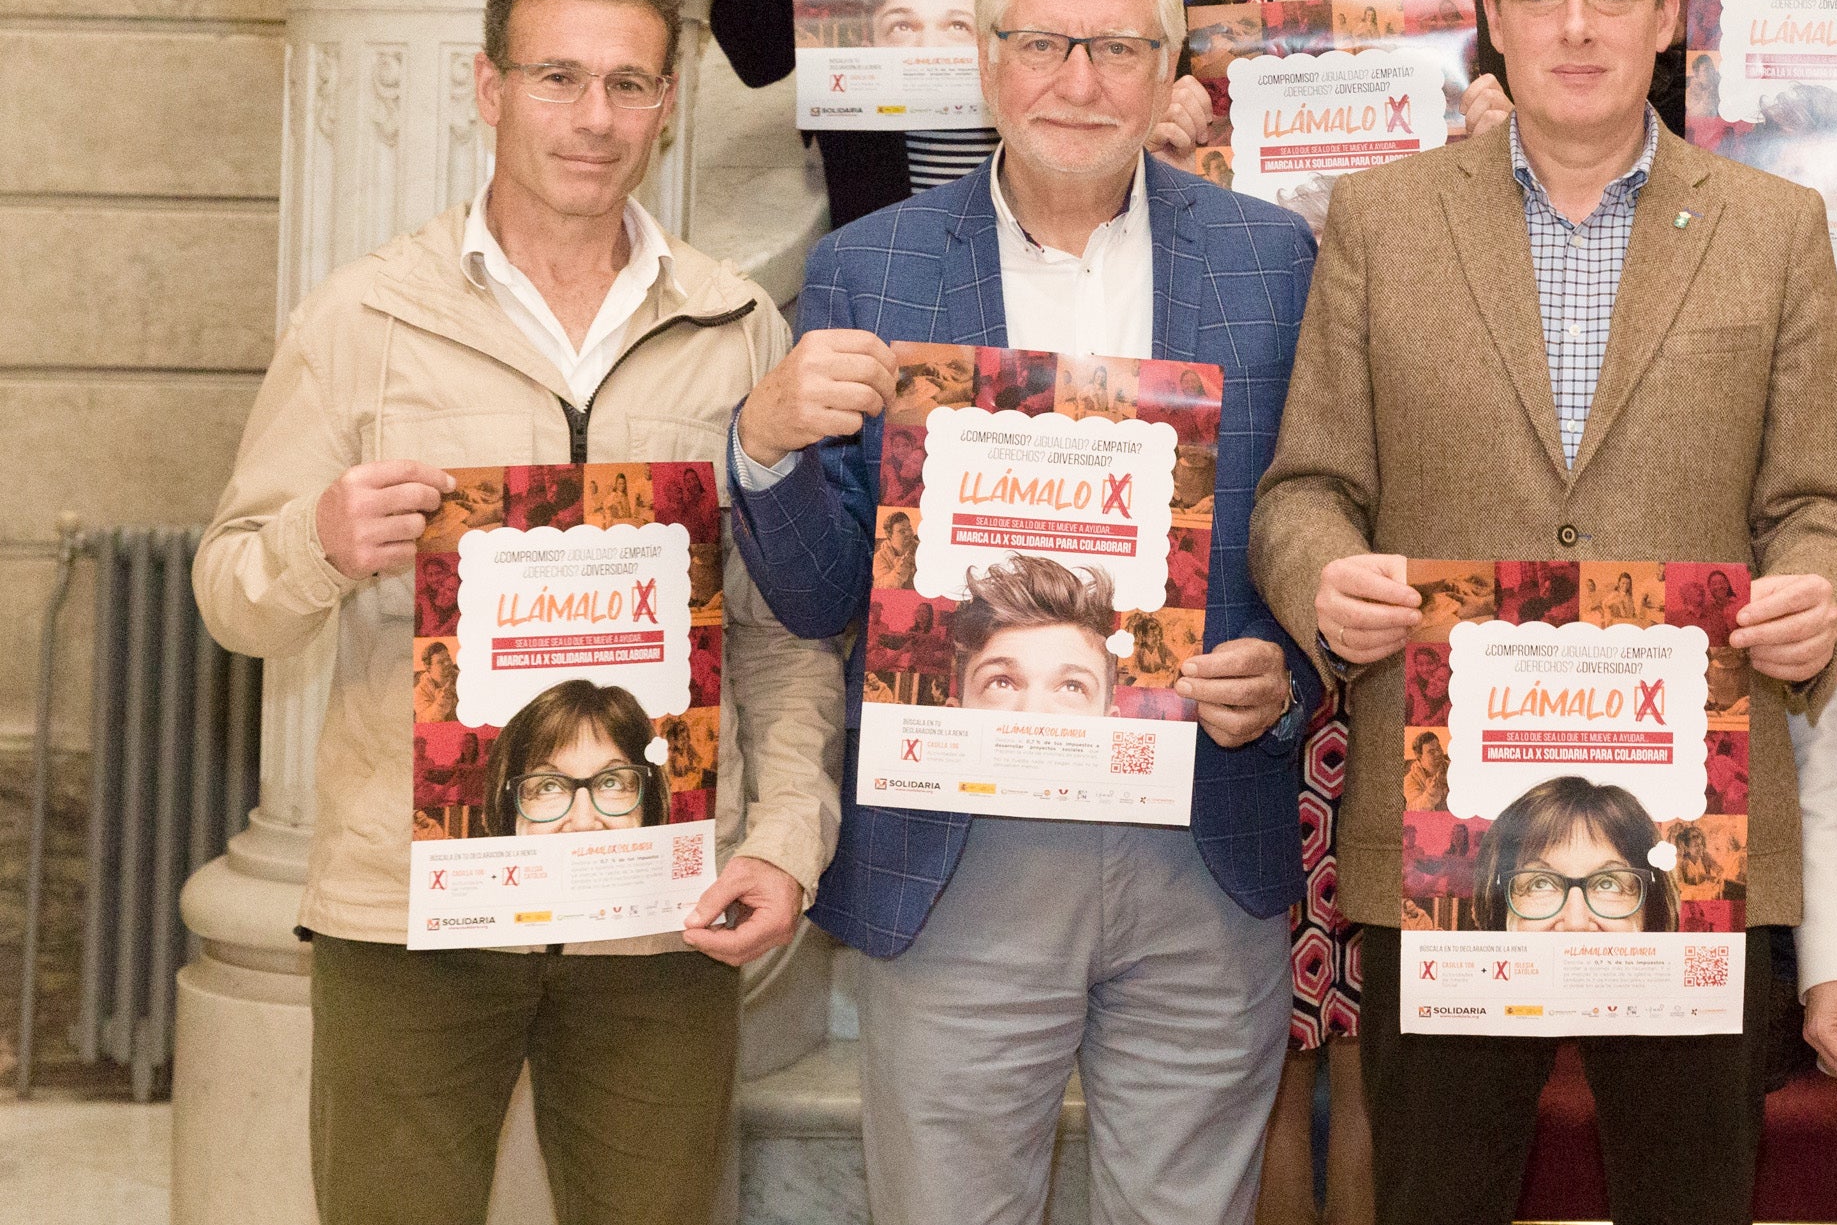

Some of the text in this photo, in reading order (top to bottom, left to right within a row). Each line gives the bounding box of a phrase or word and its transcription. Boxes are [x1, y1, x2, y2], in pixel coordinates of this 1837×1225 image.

[1258, 66, 1415, 86] ¿COMPROMISO? ¿EMPATÍA?
[1334, 81, 1391, 95] ¿DIVERSIDAD?
[1264, 102, 1376, 139] LLÁMALO
[960, 430, 1032, 446] ¿COMPROMISO?
[1091, 439, 1143, 455] ¿EMPATÍA?
[1047, 451, 1113, 467] ¿DIVERSIDAD?
[959, 468, 1092, 510] LLÁMALO
[956, 530, 1132, 555] ¡MARCA LA X SOLIDARIA PARA COLABORAR!
[495, 546, 664, 564] ¿COMPROMISO? ¿EMPATÍA?
[580, 561, 641, 576] ¿DIVERSIDAD?
[497, 584, 623, 630] LLÁMALO
[1486, 645, 1672, 659] ¿COMPROMISO? ¿IGUALDAD? ¿EMPATÍA?
[1515, 660, 1643, 674] ¿DERECHOS? ¿DIVERSIDAD?
[1488, 680, 1624, 721] LLÁMALO
[1507, 732, 1519, 741] SEA
[1520, 732, 1529, 741] LO
[1529, 732, 1542, 742] QUE
[1543, 732, 1556, 742] SEA
[1557, 732, 1565, 742] LO
[1566, 733, 1579, 742] QUE
[1580, 733, 1588, 742] TE
[1590, 733, 1611, 743] MUEVE
[1612, 733, 1618, 743] A
[1488, 747, 1668, 762] ¡MARCA LA X SOLIDARIA PARA COLABORAR!
[889, 779, 941, 790] SOLIDARIA
[442, 916, 496, 927] SOLIDARIA
